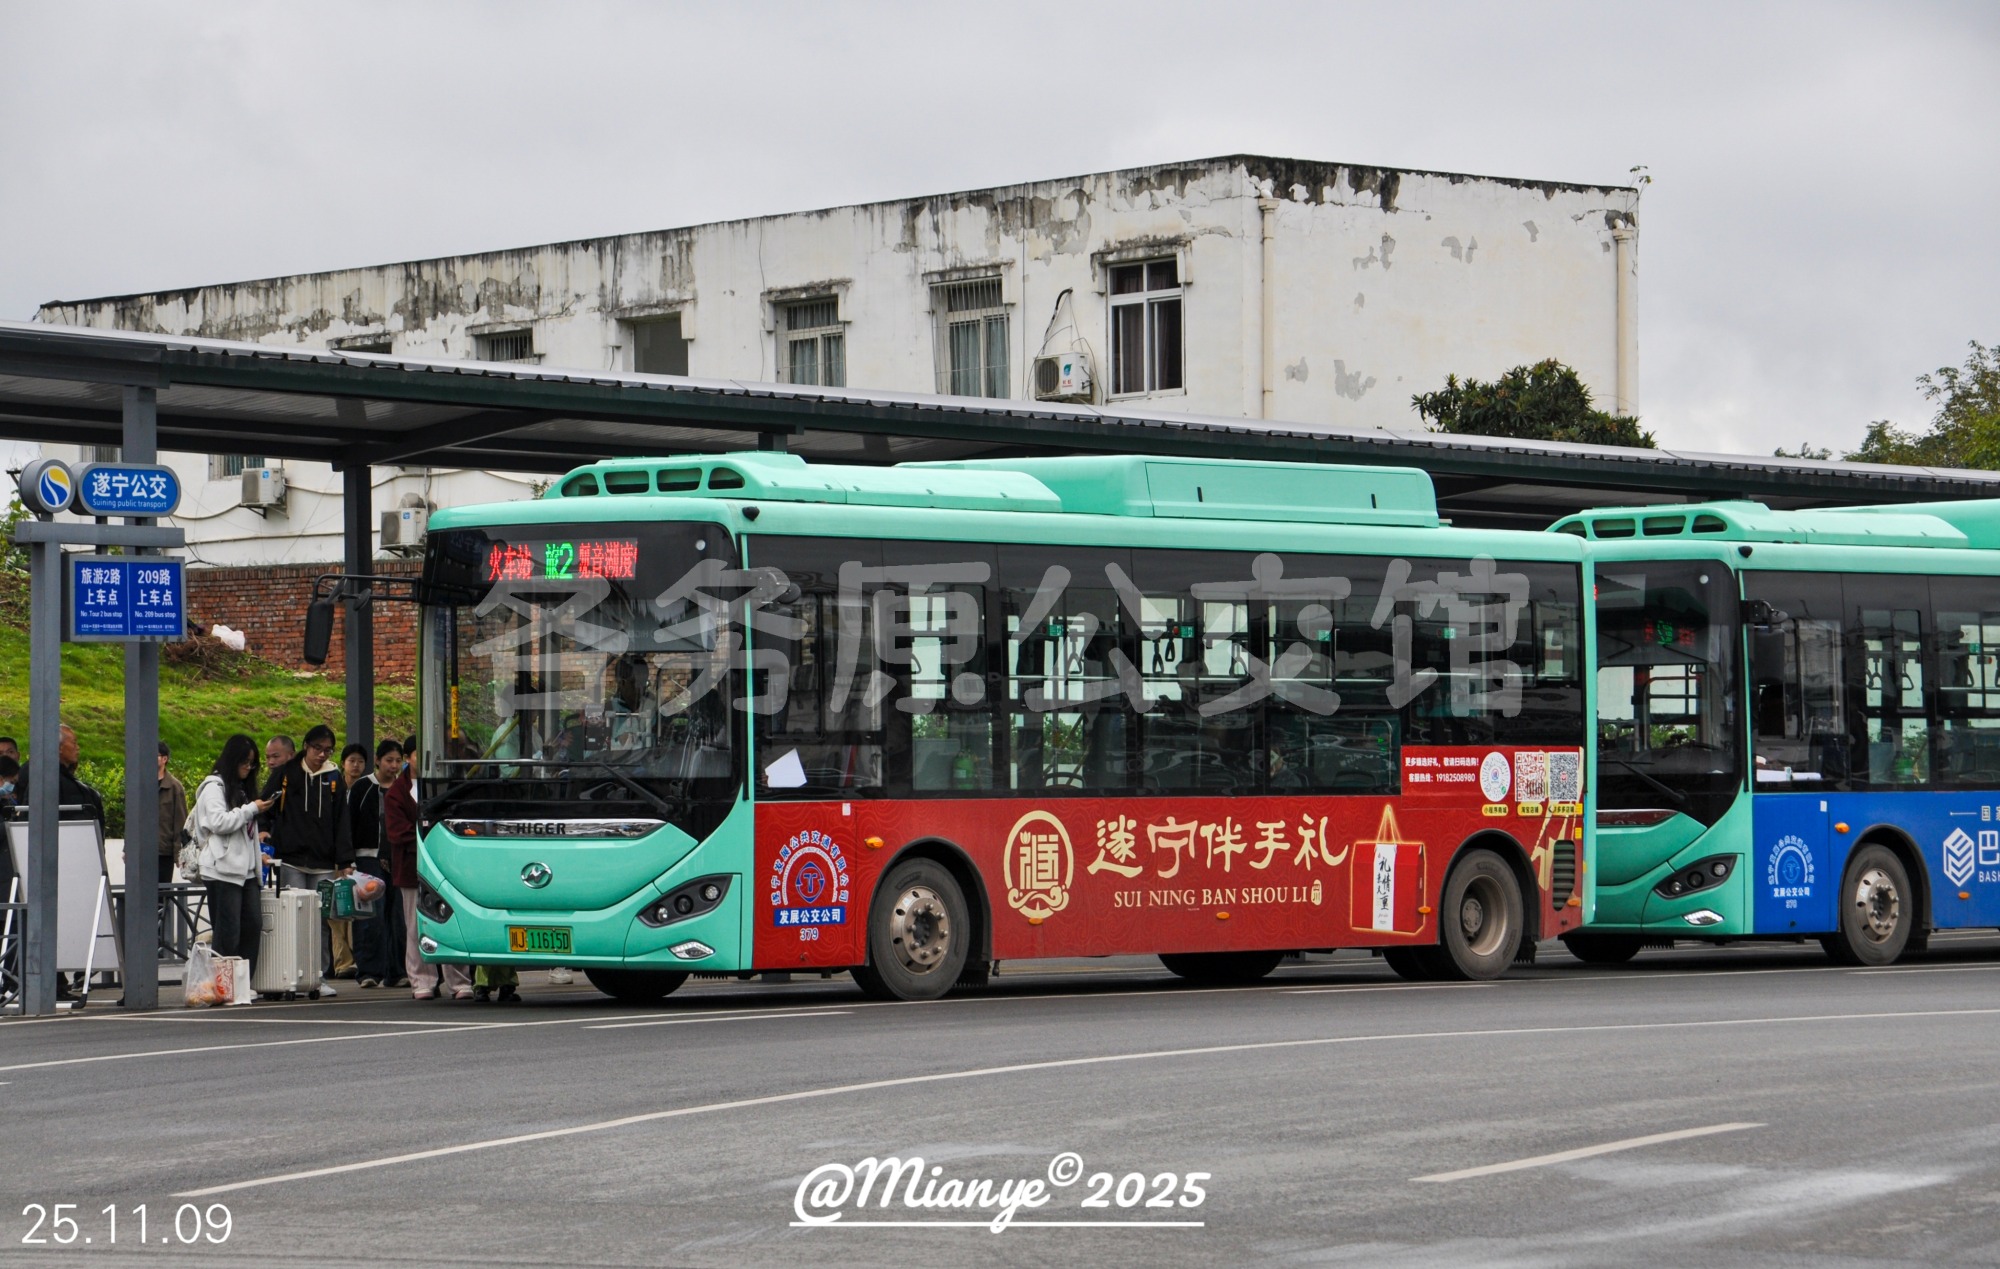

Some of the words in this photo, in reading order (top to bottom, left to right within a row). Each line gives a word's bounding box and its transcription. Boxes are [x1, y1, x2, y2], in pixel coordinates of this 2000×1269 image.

[92, 472, 167, 499] 遂宁公交
[93, 498, 116, 508] Suining
[117, 499, 137, 508] public
[138, 500, 167, 509] transport
[489, 544, 532, 581] 火车站
[81, 567, 121, 585] 旅游2路
[137, 569, 171, 585] 209路
[85, 588, 118, 606] 上车点
[137, 589, 174, 606] 上车点
[516, 822, 566, 835] HIGER
[1087, 813, 1350, 878] 遂宁伴手礼
[1114, 890, 1142, 908] SUI
[1148, 889, 1196, 906] NING
[1201, 888, 1237, 906] BAN
[1241, 886, 1289, 904] SHOU
[1292, 886, 1308, 903] LI
[779, 908, 841, 925] 发展公交公司
[530, 931, 569, 950] 11615D
[800, 928, 819, 941] 379
